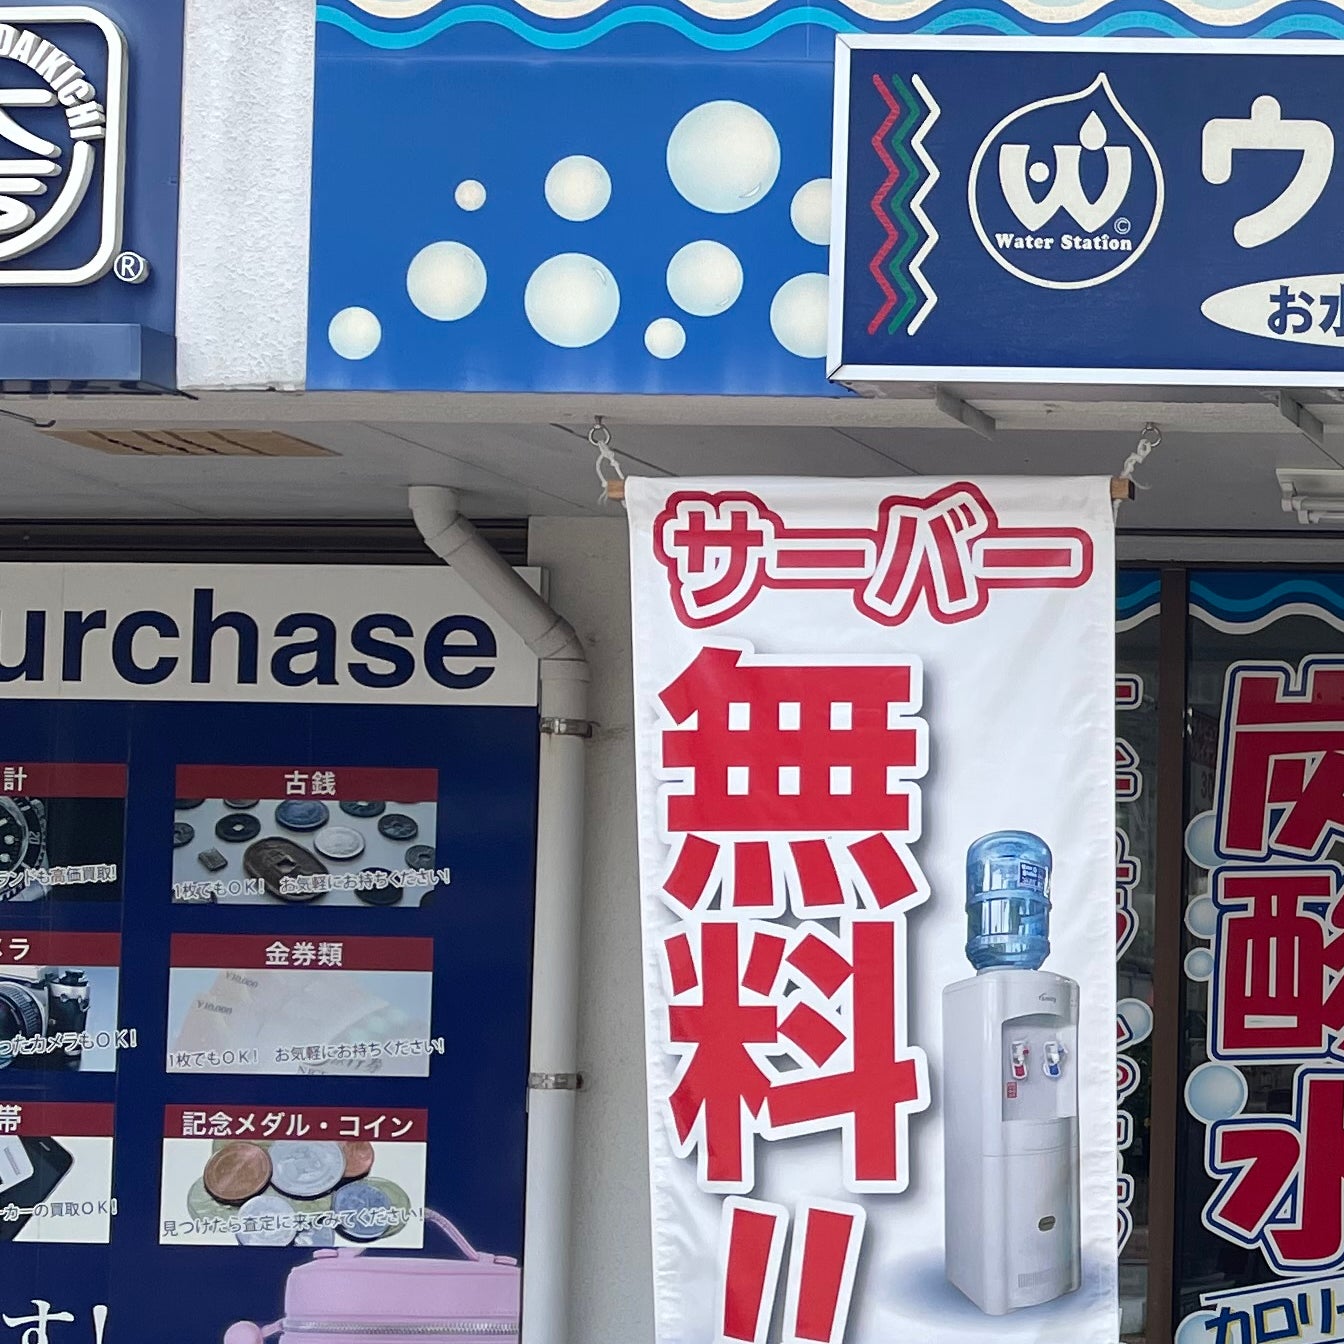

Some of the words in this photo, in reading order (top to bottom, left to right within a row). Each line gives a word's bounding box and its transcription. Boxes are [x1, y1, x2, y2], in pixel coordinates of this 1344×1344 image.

[995, 233, 1054, 250] Water
[1061, 233, 1132, 251] Station
[653, 483, 1093, 629] サーバー
[284, 770, 337, 796] 古銭
[265, 940, 344, 967] 金券類
[182, 1110, 414, 1138] 記念メダル・コイン
